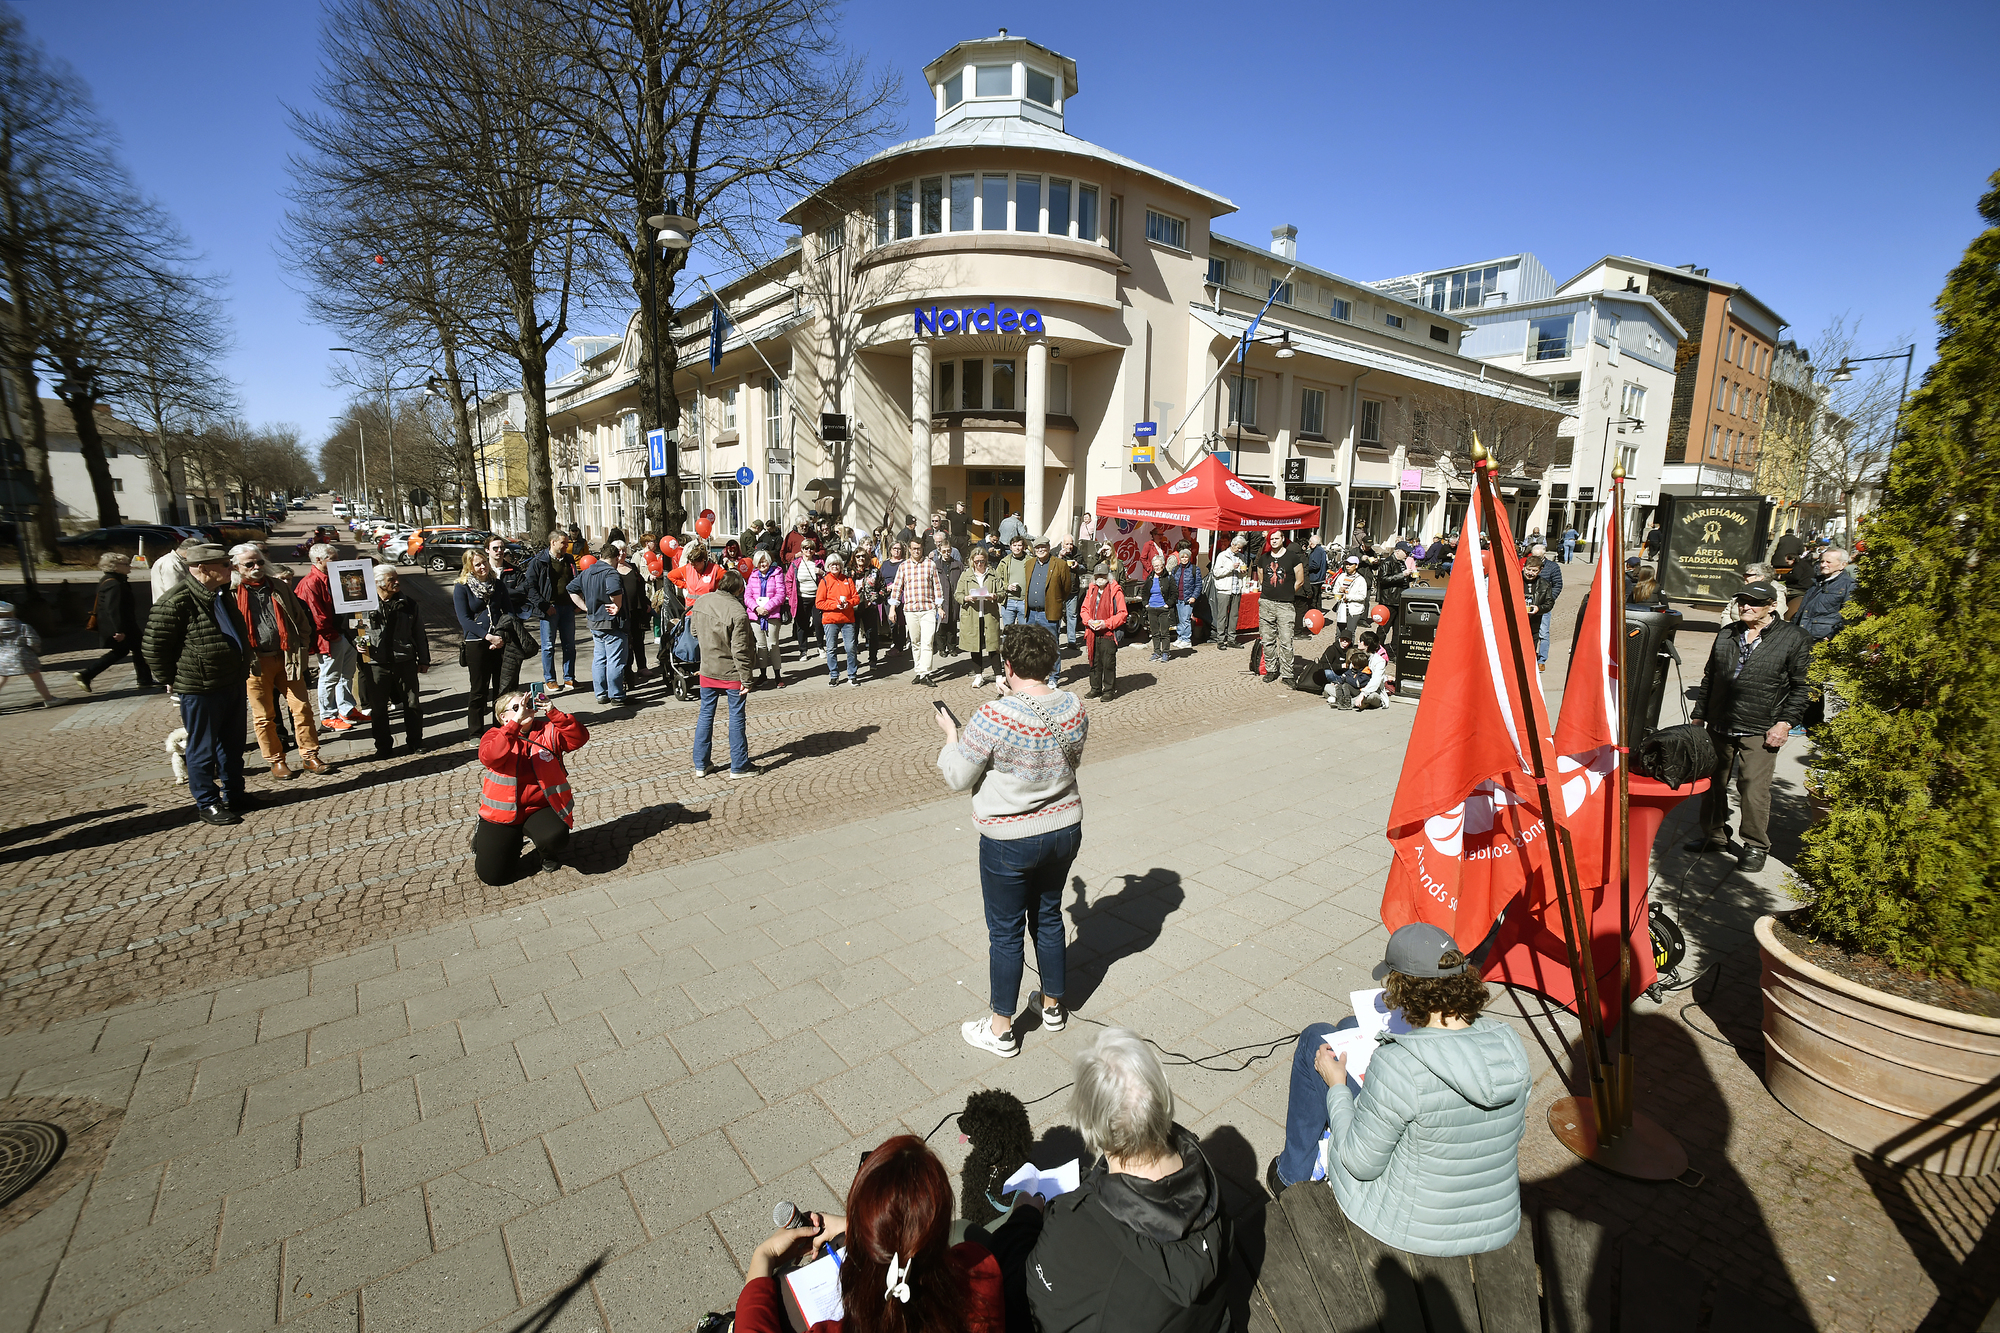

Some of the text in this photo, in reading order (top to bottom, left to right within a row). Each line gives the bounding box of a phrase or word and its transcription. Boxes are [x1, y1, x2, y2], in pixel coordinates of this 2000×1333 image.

[914, 301, 1043, 334] Nordea
[1138, 509, 1191, 522] SOCIALDEMOKRATER
[1682, 508, 1748, 525] MARIEHAMN
[1695, 546, 1723, 557] ÅRETS
[1678, 556, 1739, 566] STADSKÄRNA
